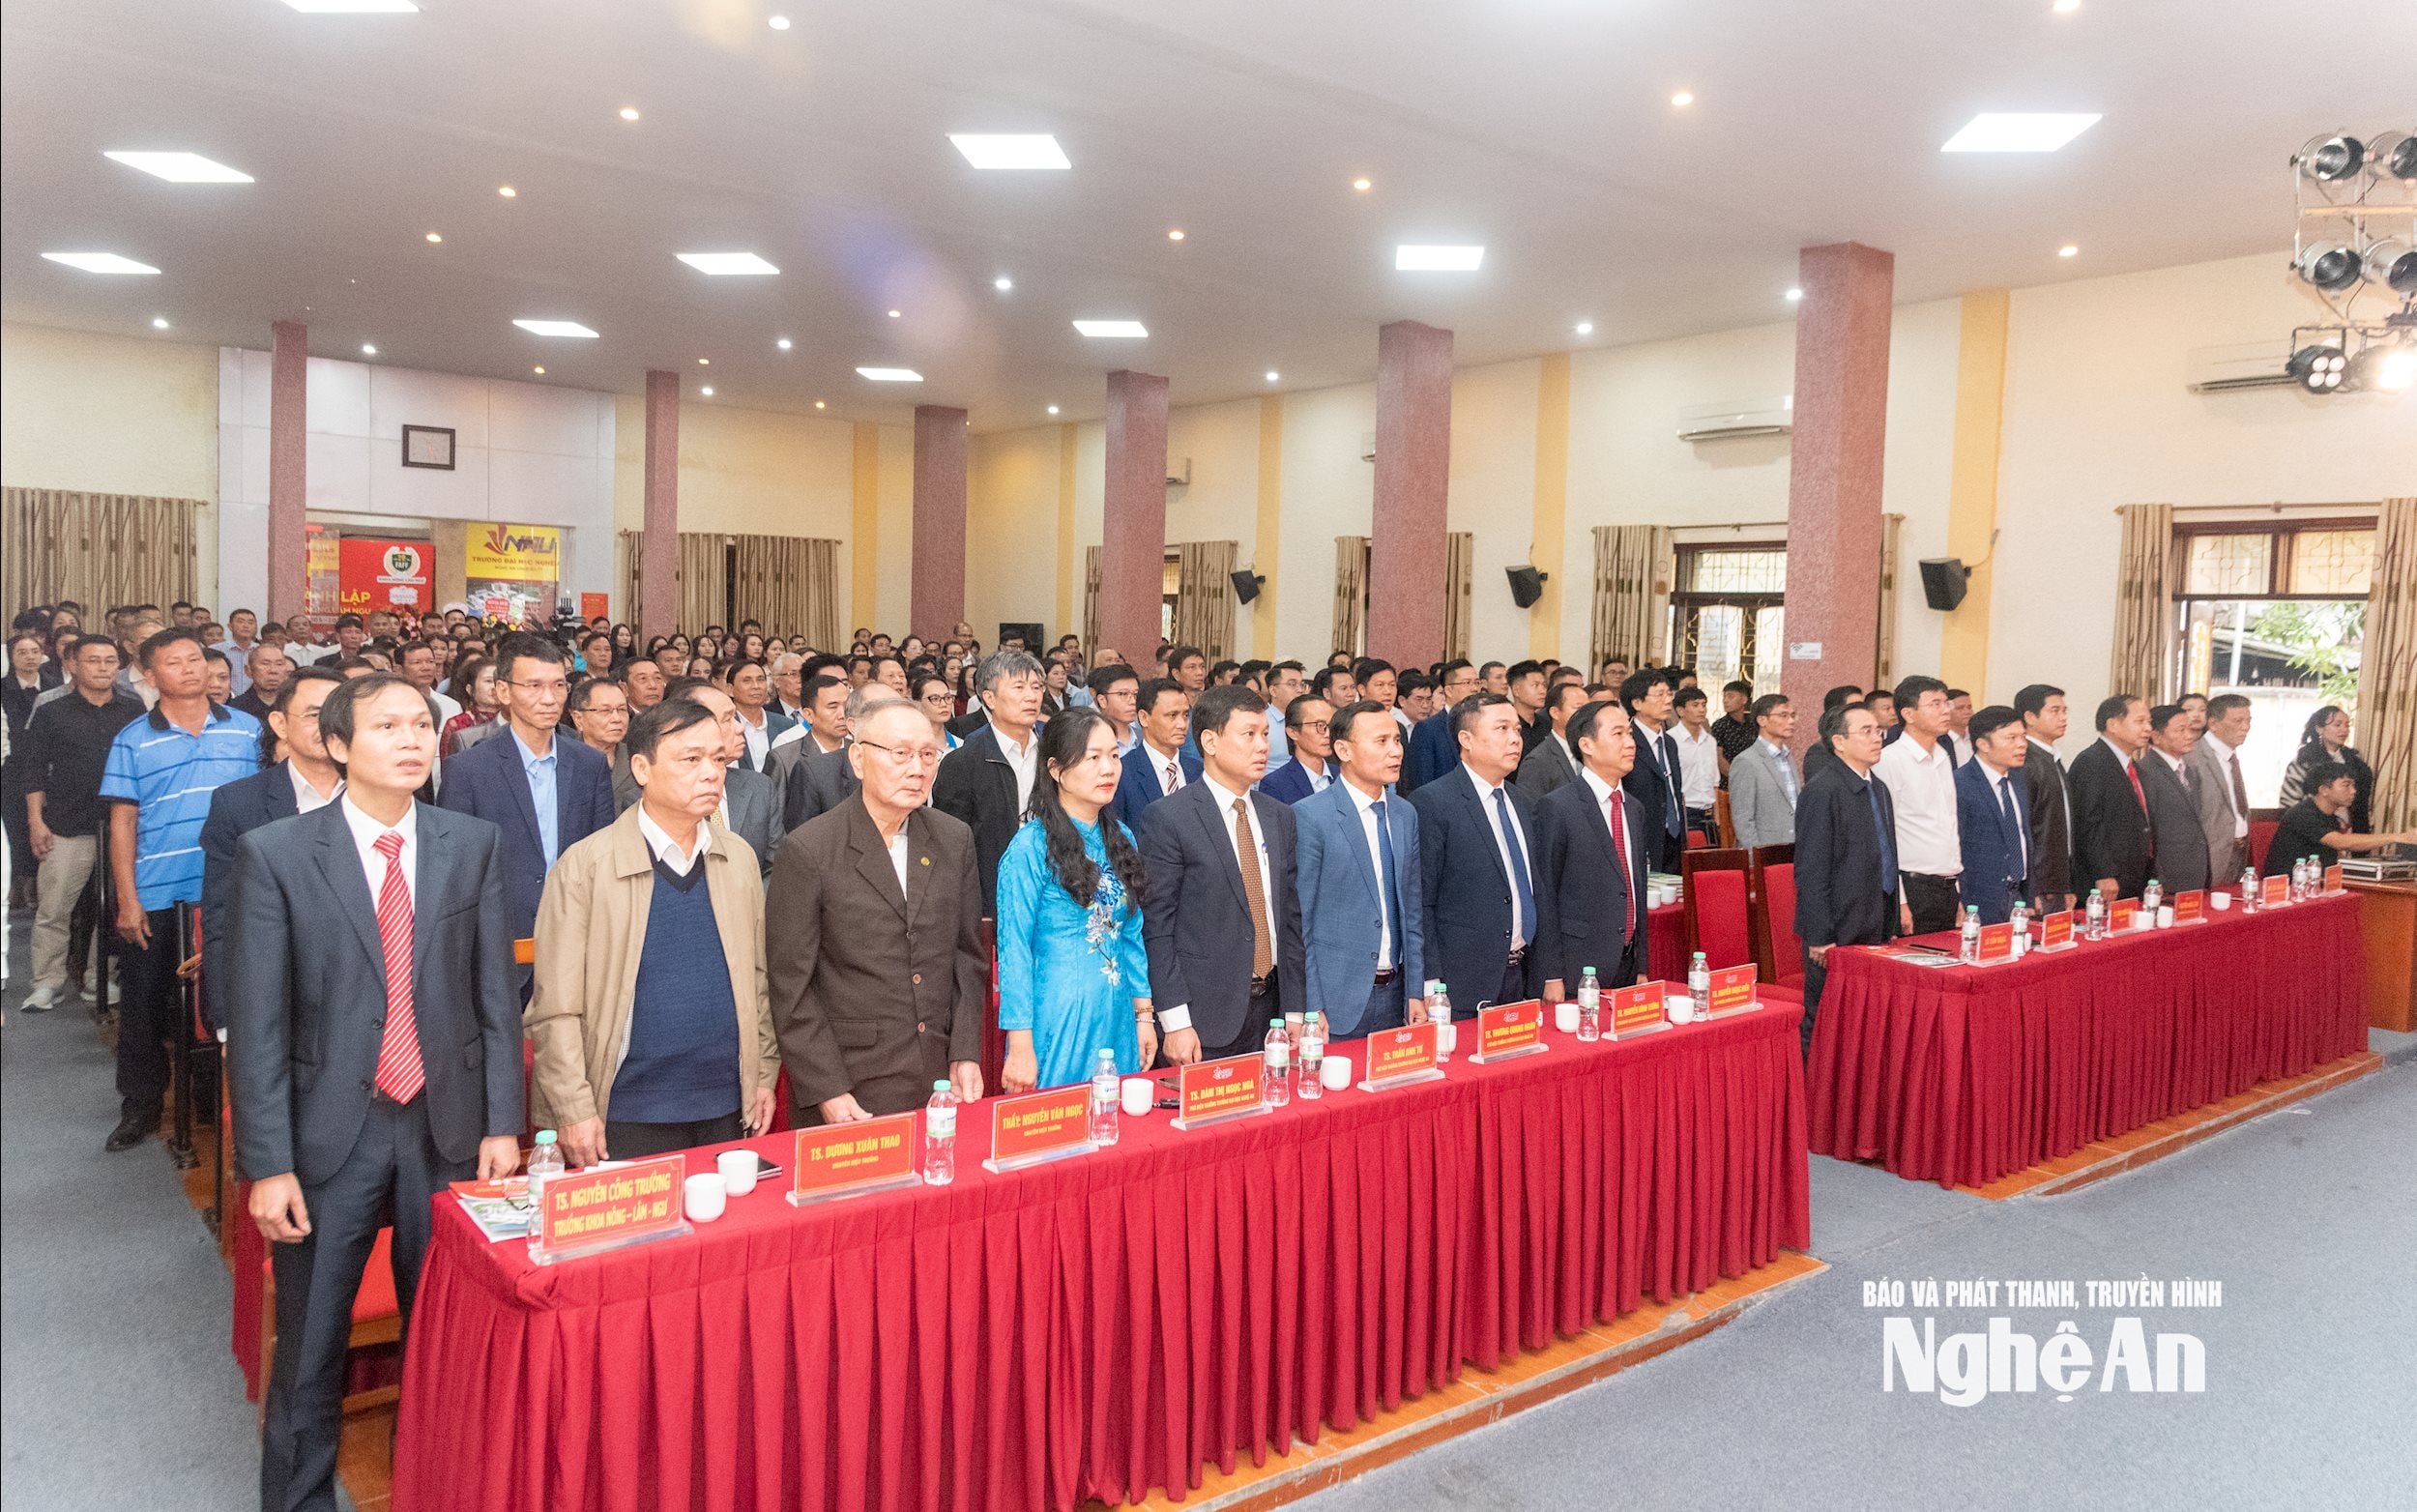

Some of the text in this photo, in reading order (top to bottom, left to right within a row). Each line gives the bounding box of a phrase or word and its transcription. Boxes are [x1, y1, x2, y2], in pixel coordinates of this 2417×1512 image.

[340, 588, 371, 605] LẬP
[1406, 1046, 1415, 1057] ANH
[1190, 1090, 1200, 1101] TS.
[1215, 1085, 1224, 1096] THỊ
[1226, 1082, 1241, 1094] NGỌC
[1022, 1108, 1049, 1126] NGUYỄN
[1050, 1105, 1063, 1121] VĂN
[1065, 1104, 1083, 1119] NGỌC
[810, 1134, 901, 1161] TS. DƯƠNG XUÂN THAO
[555, 1170, 671, 1211] TS. NGUYỄN CÔNG TRƯỜNG
[585, 1212, 605, 1232] KHOA
[605, 1205, 626, 1228] NÔNG
[632, 1199, 648, 1222] LÂM
[652, 1197, 669, 1218] NGƯ
